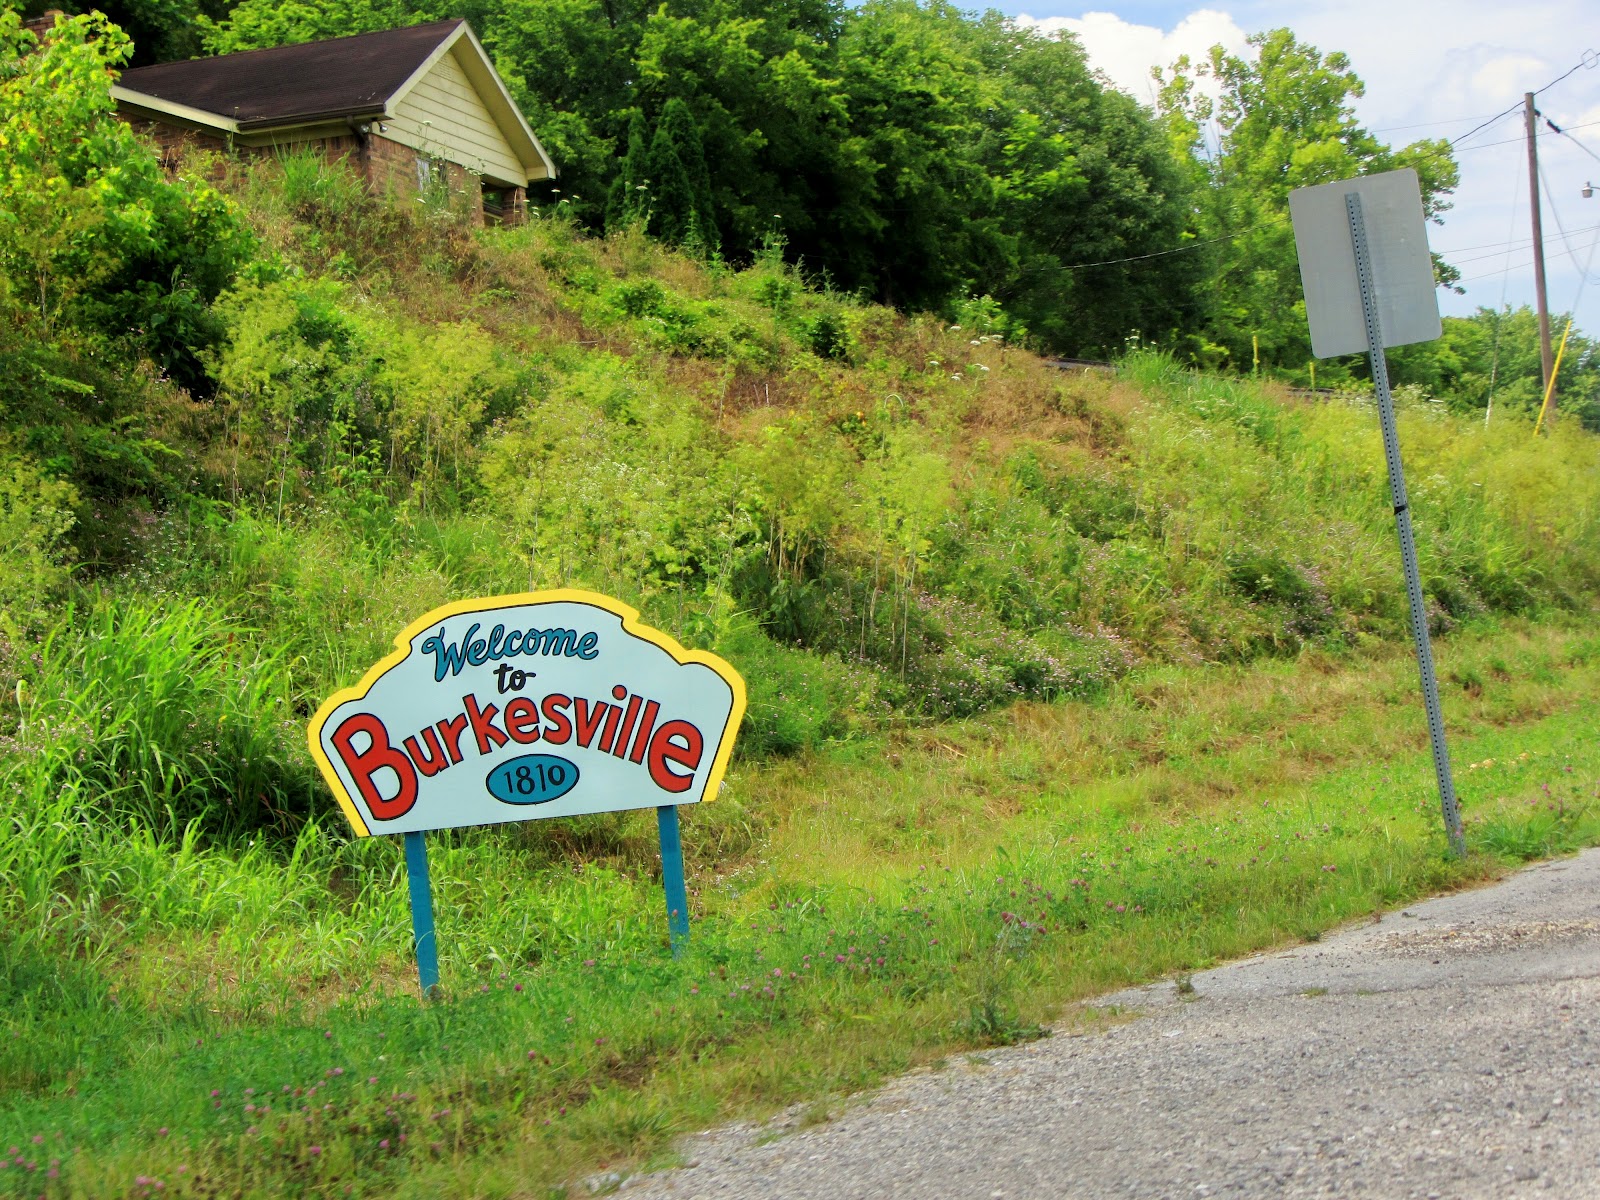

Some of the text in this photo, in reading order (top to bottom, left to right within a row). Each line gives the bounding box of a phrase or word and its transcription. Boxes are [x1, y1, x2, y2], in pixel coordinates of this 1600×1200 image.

[421, 622, 599, 682] Welcome
[493, 663, 536, 694] to
[330, 684, 703, 821] Burkesville
[504, 765, 566, 794] 1810
